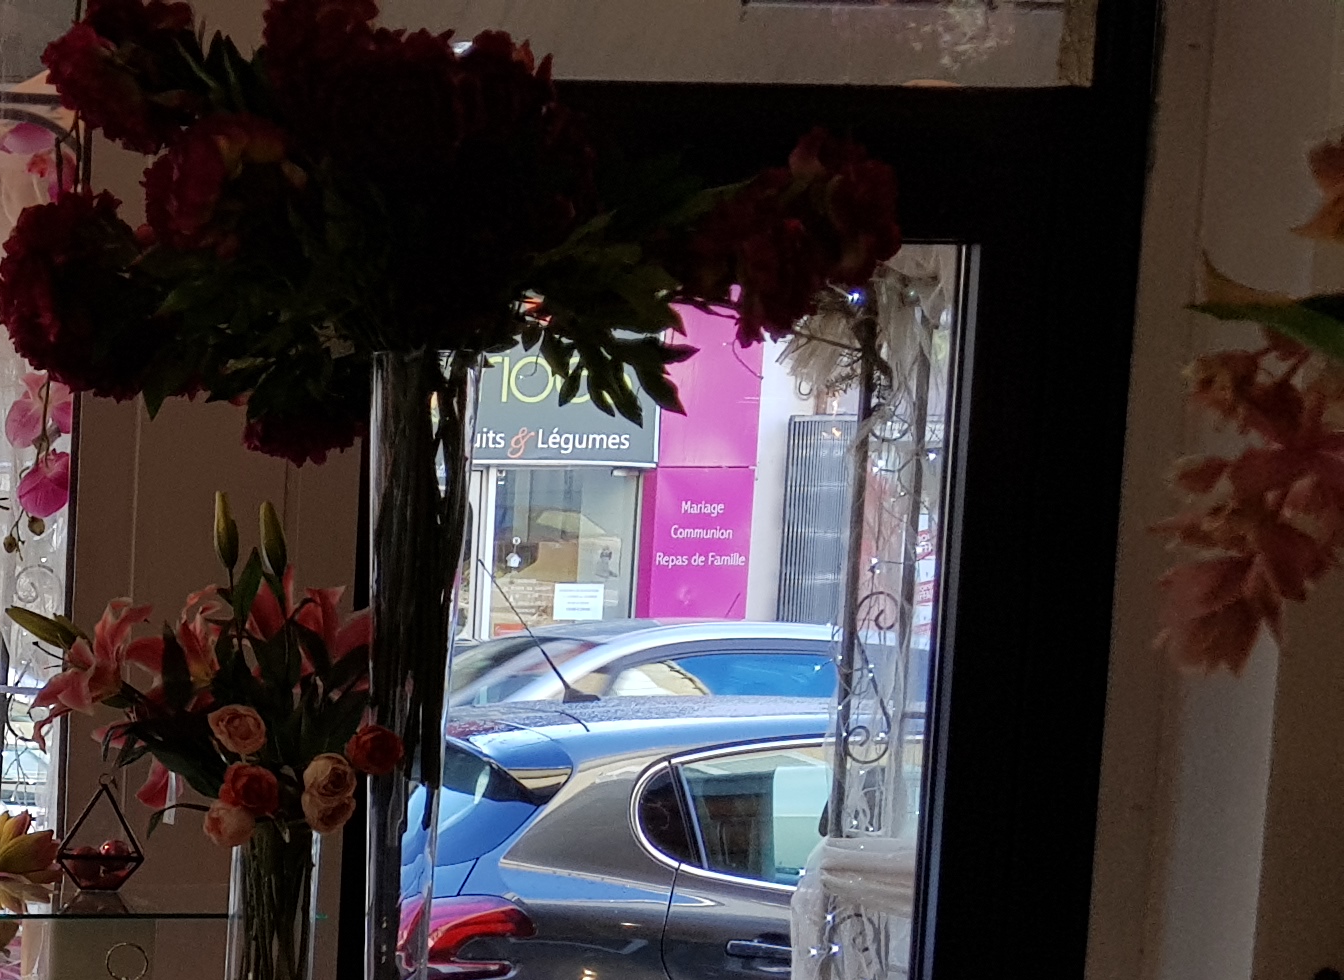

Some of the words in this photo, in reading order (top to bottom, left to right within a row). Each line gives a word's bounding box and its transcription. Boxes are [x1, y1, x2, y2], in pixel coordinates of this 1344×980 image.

[507, 426, 536, 459] &
[537, 427, 631, 454] Légumes
[680, 500, 725, 518] Mariage
[670, 524, 734, 540] Communion
[655, 551, 689, 569] Repas
[690, 552, 706, 566] de
[707, 552, 747, 566] Famille
